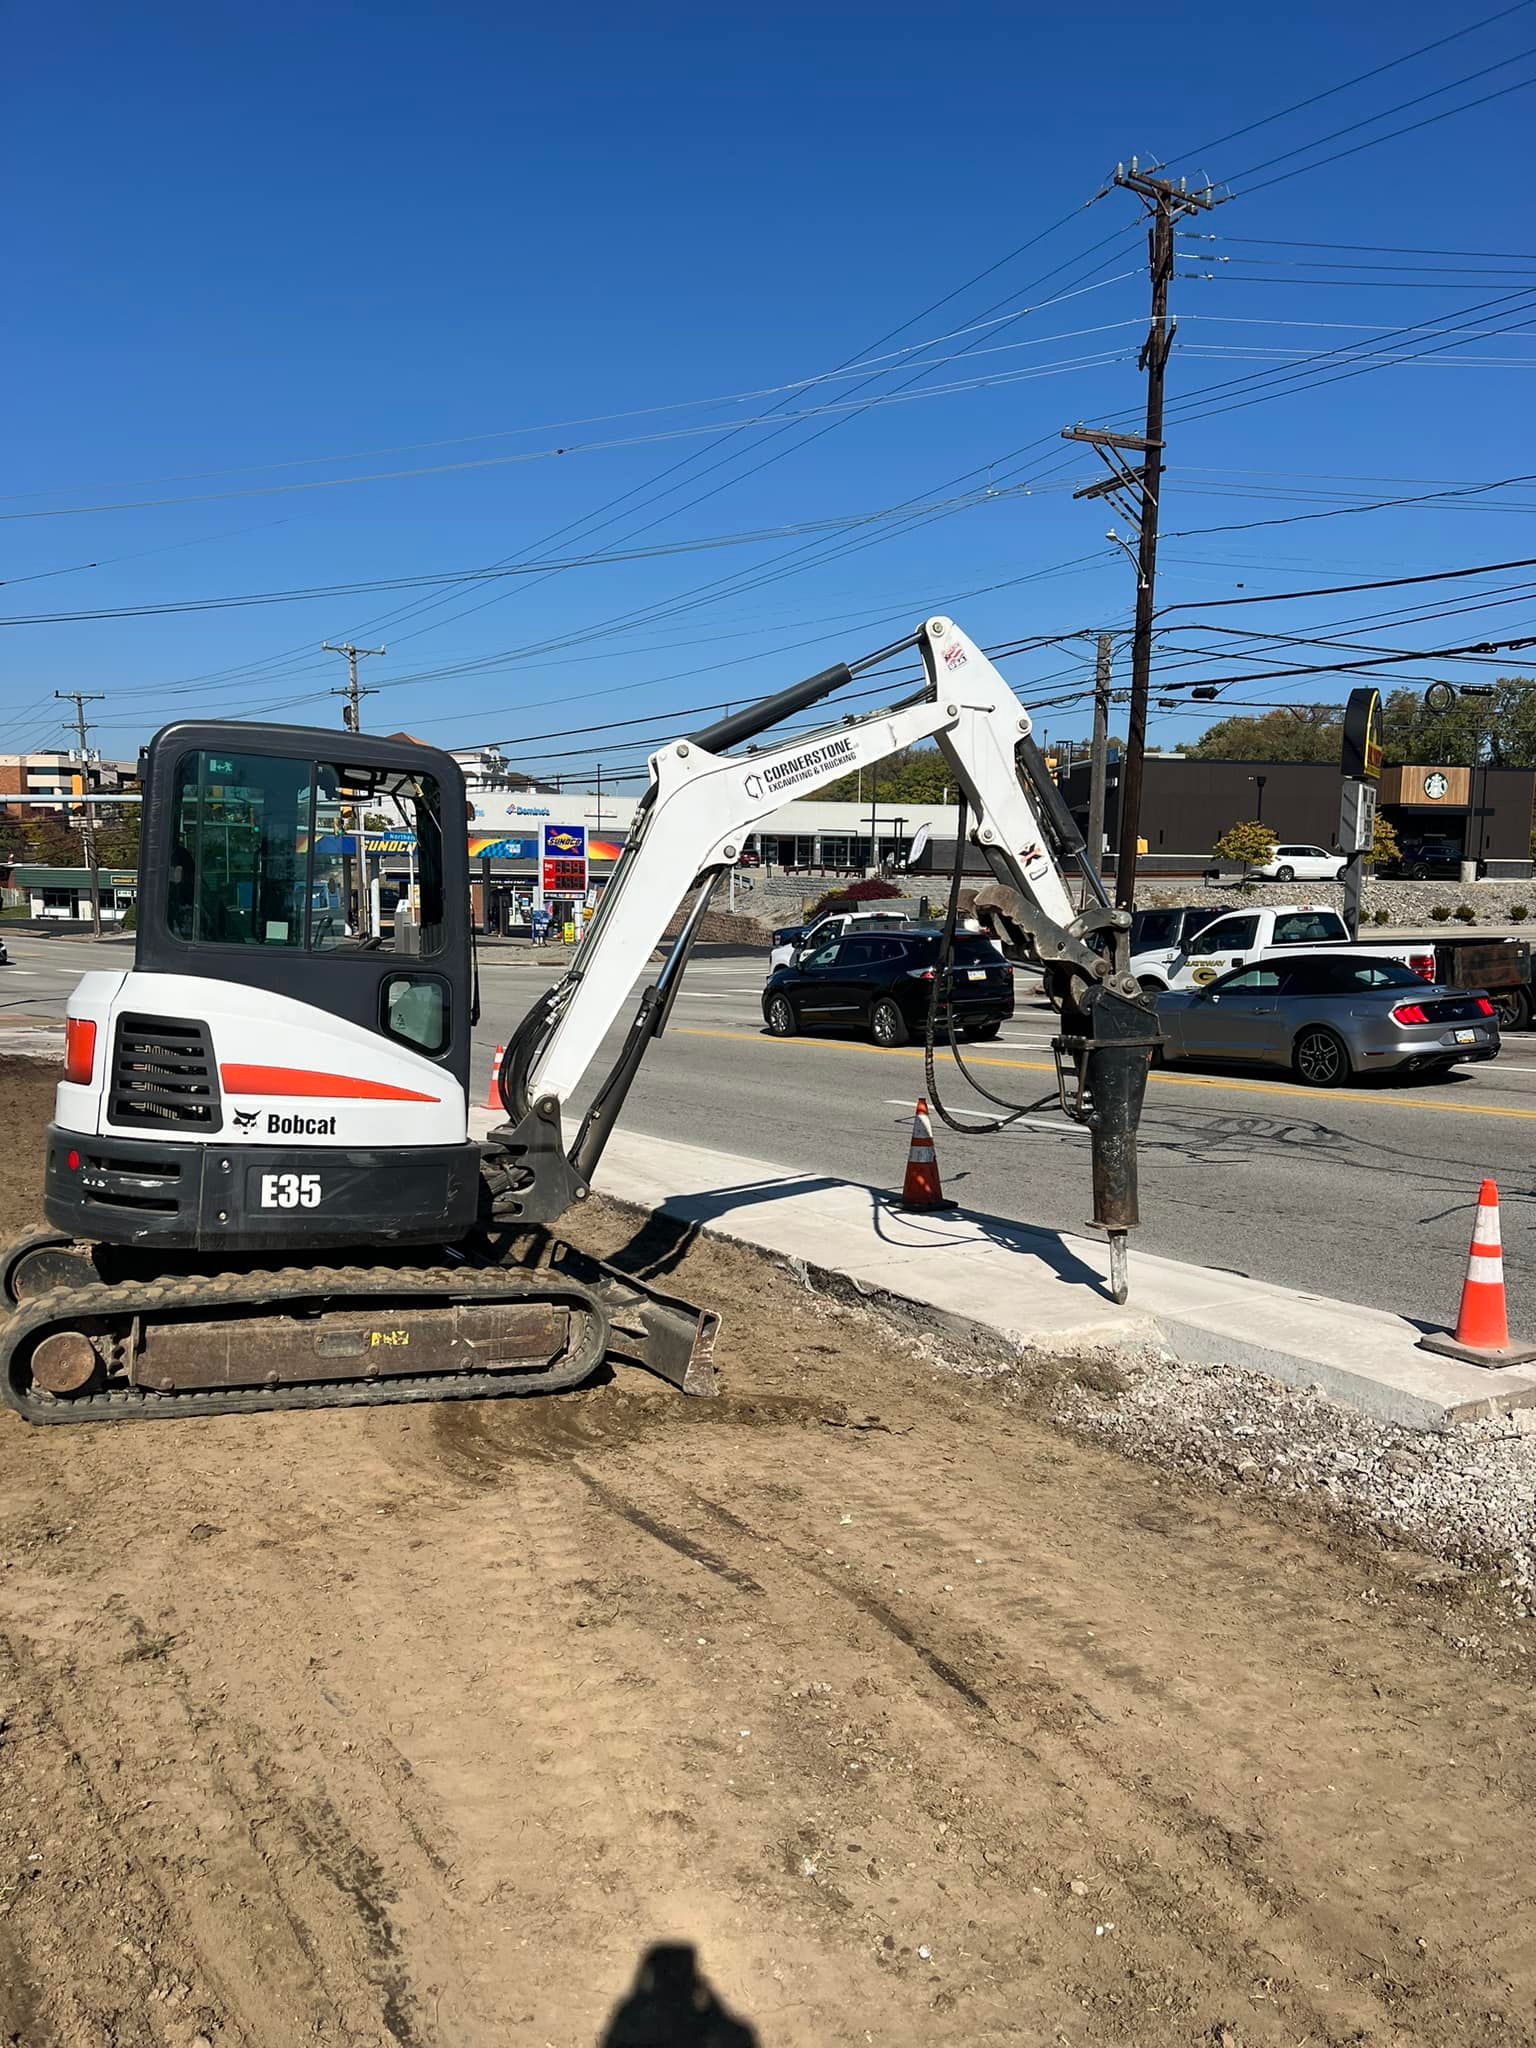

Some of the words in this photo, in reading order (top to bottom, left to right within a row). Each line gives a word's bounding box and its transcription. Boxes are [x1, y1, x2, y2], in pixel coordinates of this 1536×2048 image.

[763, 738, 852, 783] CORNERSTONE
[768, 769, 814, 793] EXCAVATING
[814, 766, 820, 775] &
[820, 751, 857, 772] TRUCKING
[516, 807, 550, 816] Domino's
[364, 840, 417, 852] SUNOCO
[547, 837, 583, 847] SUNOCO
[267, 1114, 336, 1135] Bobcat
[260, 1174, 322, 1208] E35
